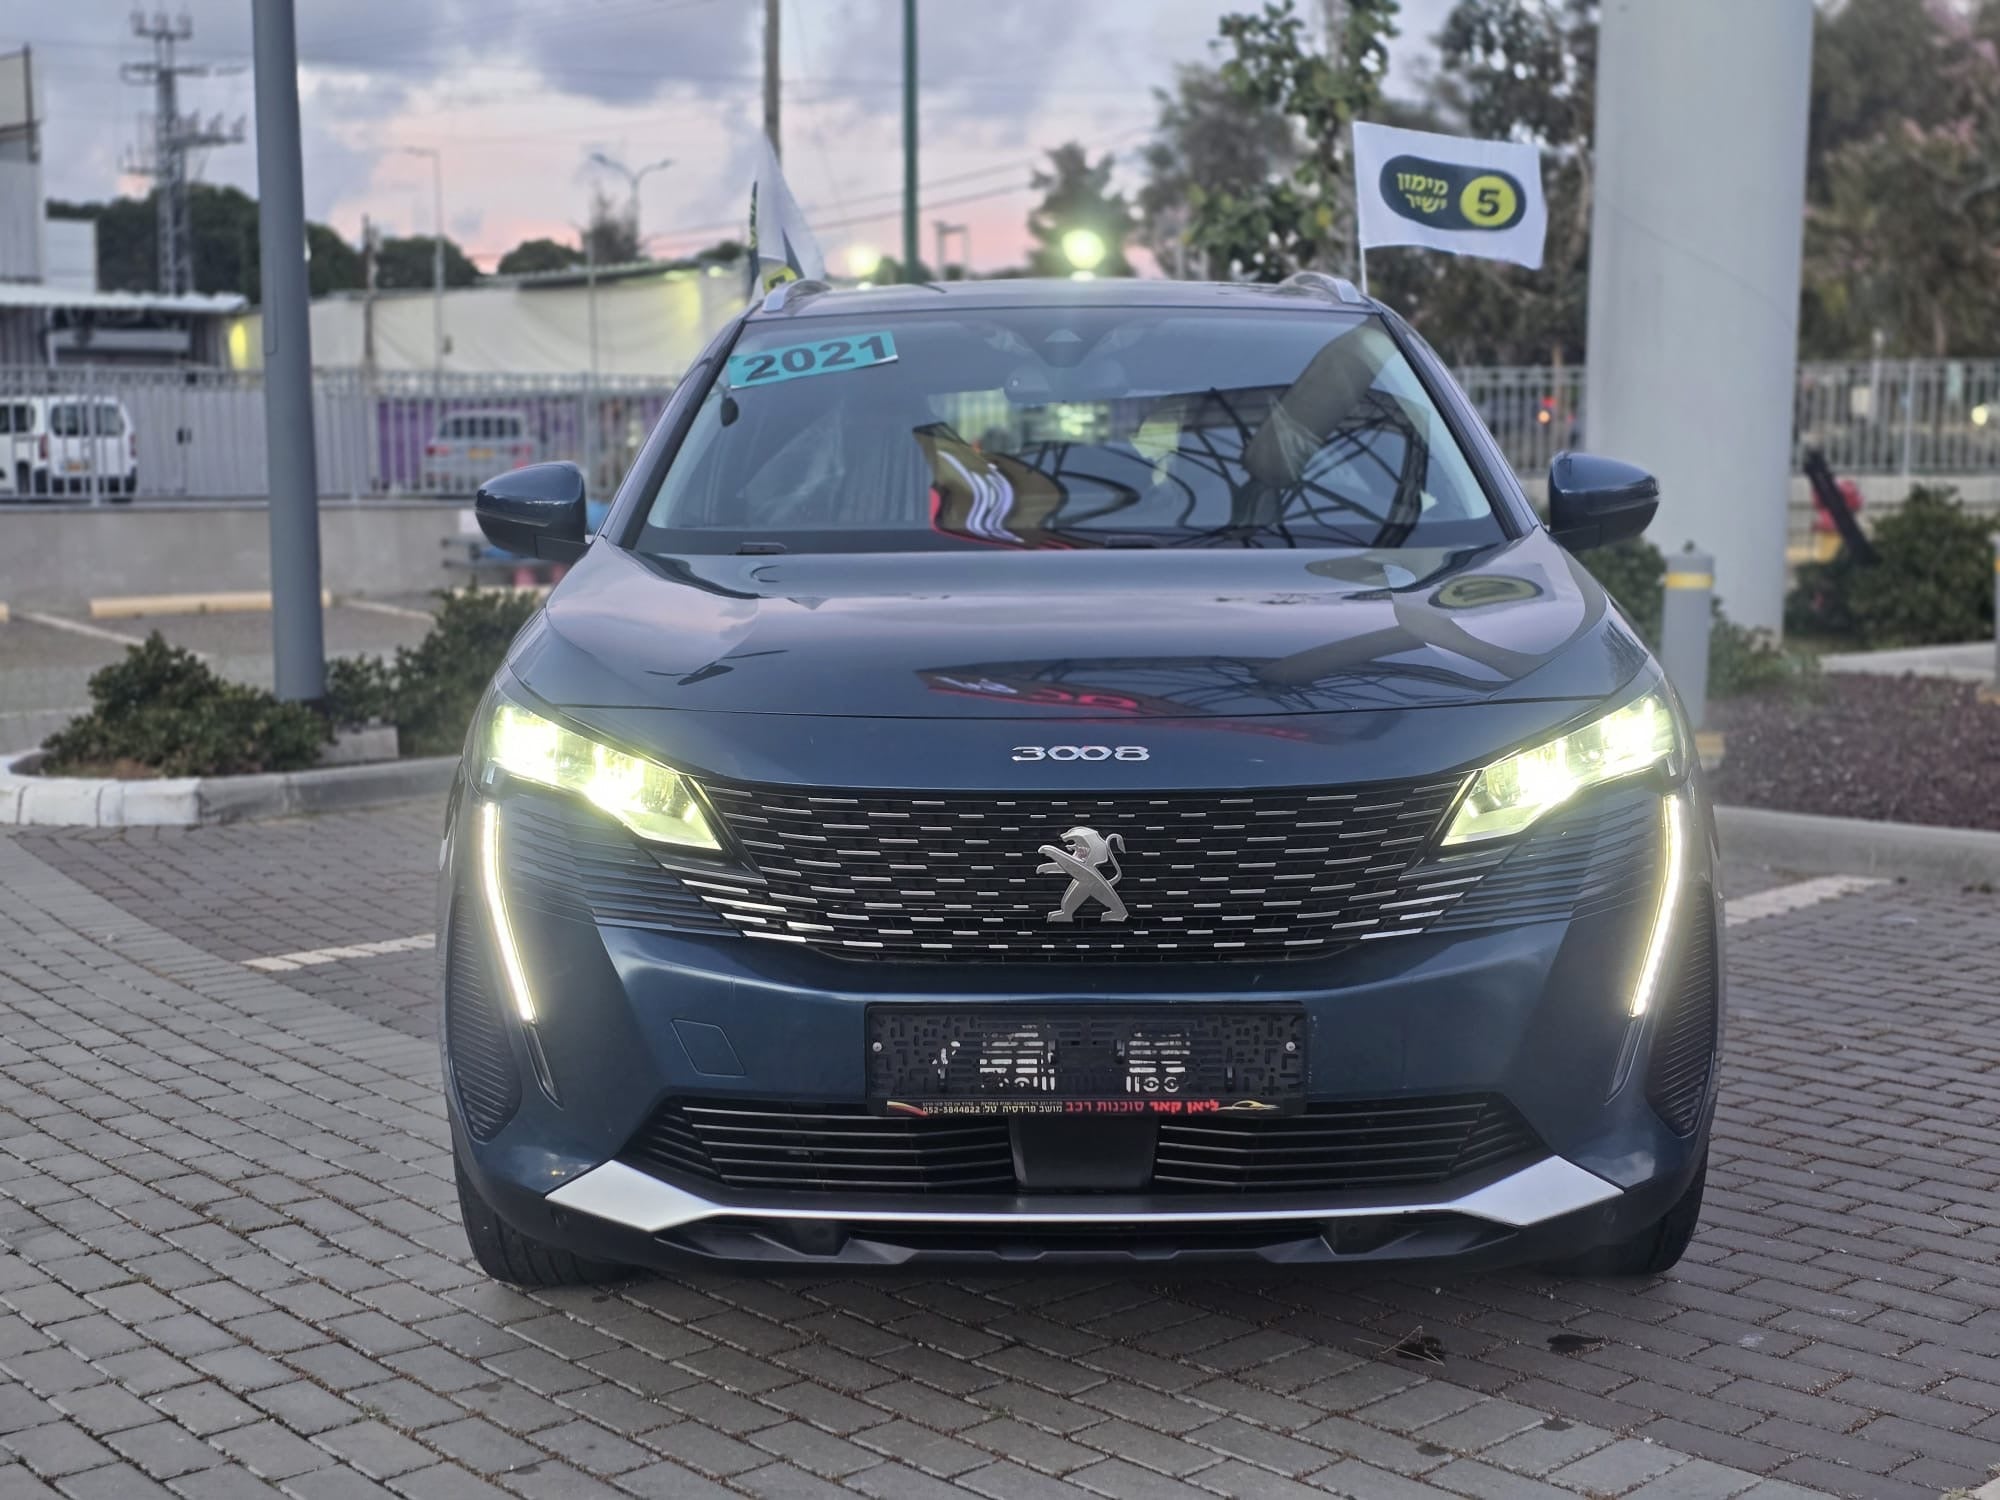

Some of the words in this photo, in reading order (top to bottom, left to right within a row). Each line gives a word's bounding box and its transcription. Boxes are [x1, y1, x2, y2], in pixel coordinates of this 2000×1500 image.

[1397, 172, 1449, 196] מימון
[1406, 194, 1448, 214] ישיר
[1476, 188, 1501, 217] 5
[743, 335, 889, 382] 2021
[1012, 746, 1150, 761] 3008
[1002, 1105, 1037, 1113] פרדסיה
[1039, 1105, 1063, 1113] מושב
[1066, 1101, 1092, 1112] רכב
[1097, 1101, 1144, 1112] סוכנות
[1150, 1101, 1182, 1113] קאר
